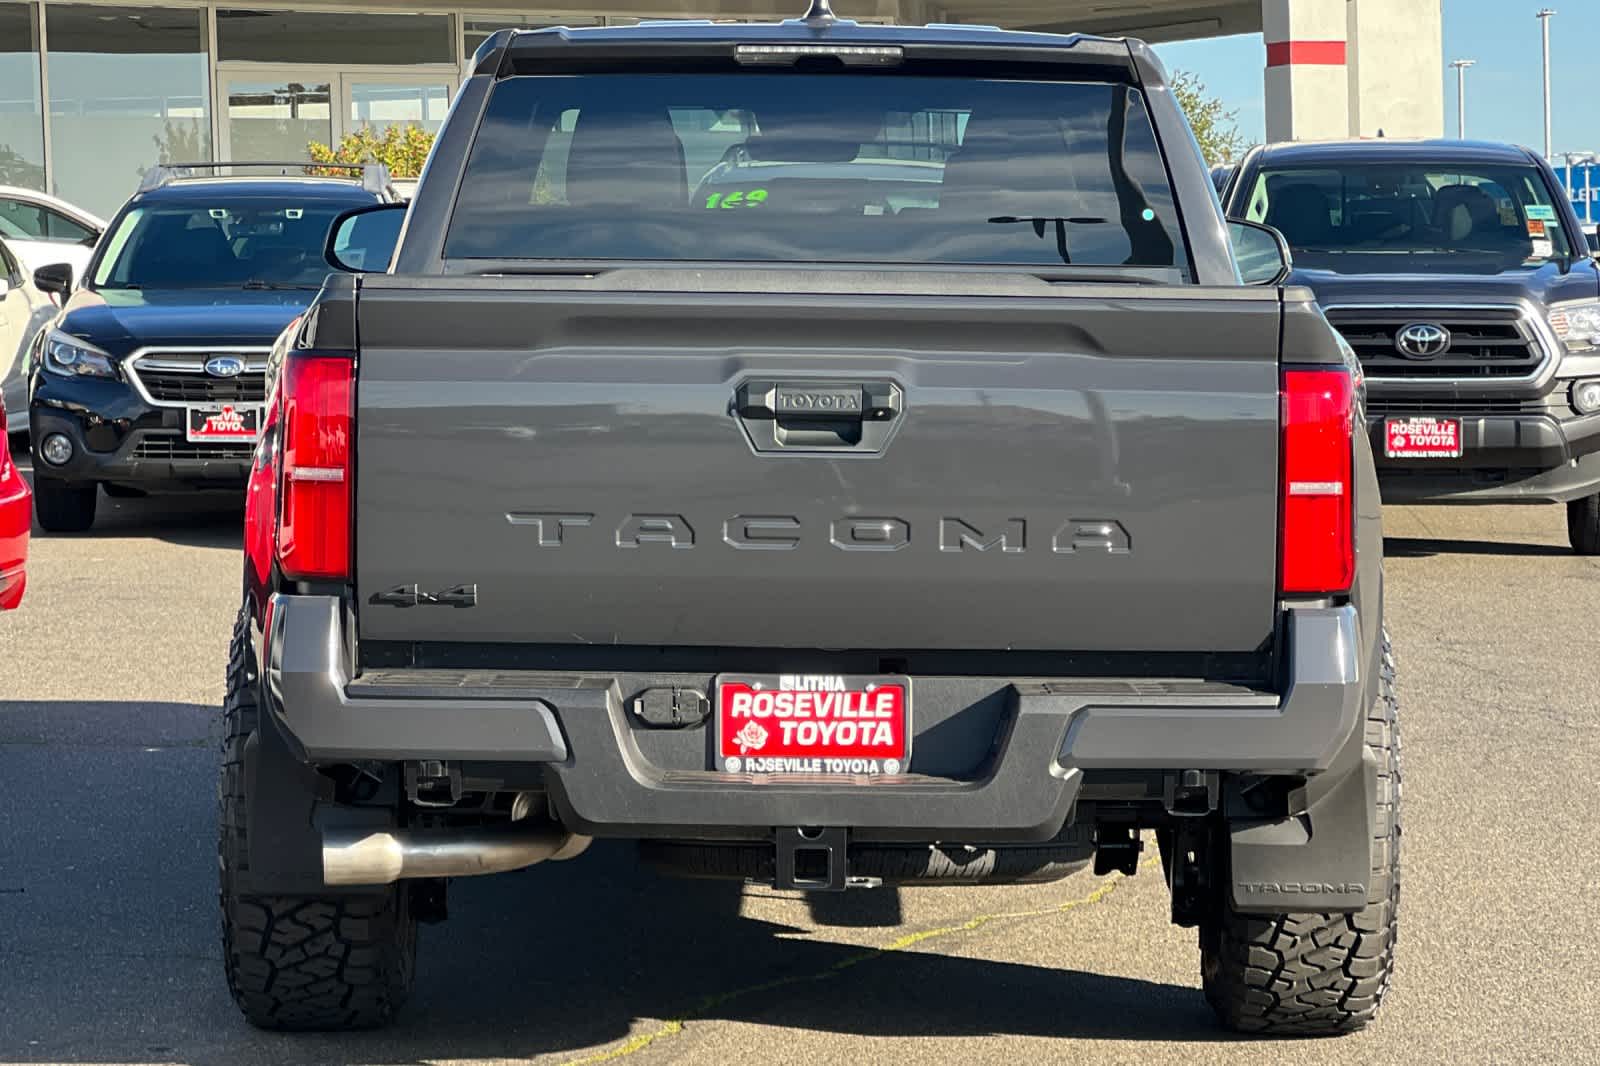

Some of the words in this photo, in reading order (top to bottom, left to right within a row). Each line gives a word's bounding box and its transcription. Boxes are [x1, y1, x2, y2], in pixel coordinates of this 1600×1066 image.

[780, 393, 859, 409] TOYOTA
[1390, 424, 1456, 435] ROSEVILLE
[1409, 435, 1455, 447] TOYOTA
[505, 512, 1133, 554] TACOMA
[731, 692, 894, 718] ROSEVILLE
[779, 720, 894, 746] TOYOTA
[745, 757, 821, 772] ROSEVILLE
[824, 758, 879, 773] TOYOTA
[1238, 882, 1365, 894] TACOMA
